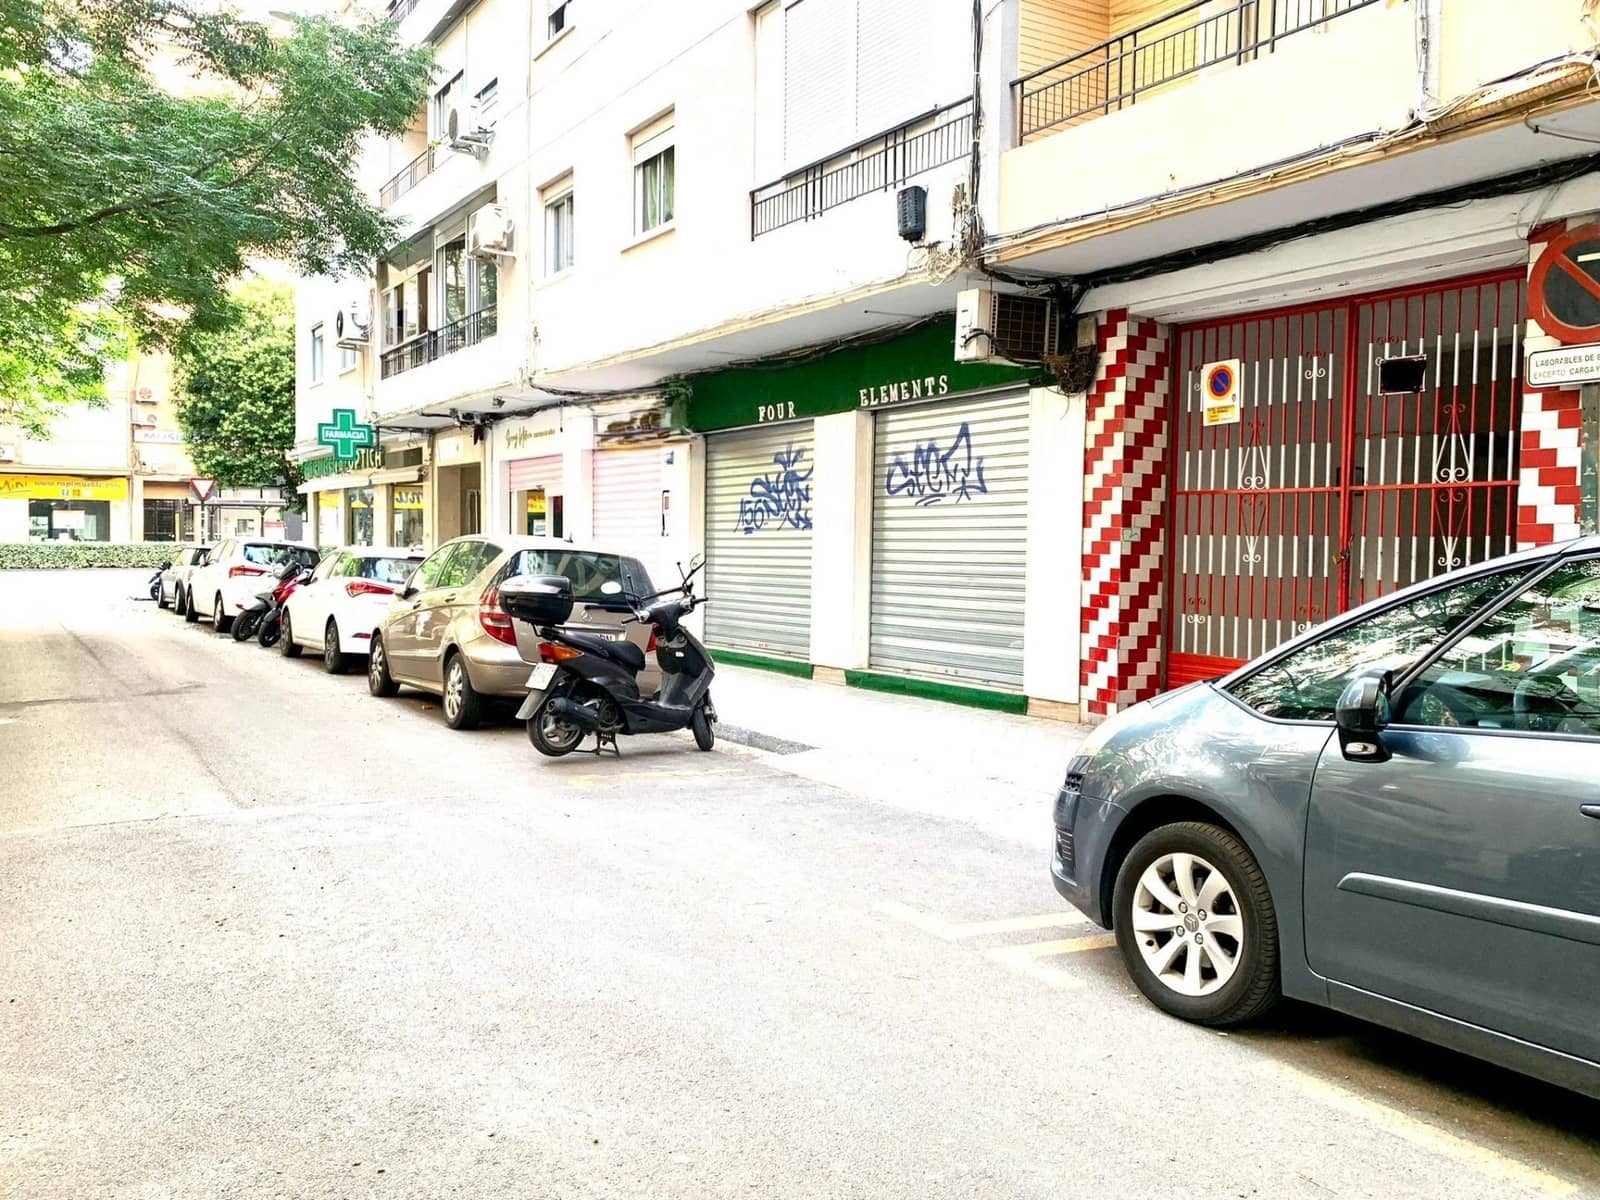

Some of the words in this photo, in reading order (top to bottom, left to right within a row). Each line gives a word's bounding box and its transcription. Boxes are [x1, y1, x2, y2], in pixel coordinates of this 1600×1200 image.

[1535, 355, 1583, 367] LABORABLES
[1584, 353, 1595, 362] DE
[1569, 366, 1594, 375] CARGA
[757, 402, 796, 422] FOUR
[859, 375, 949, 406] ELEMENTS
[325, 430, 365, 439] FARMACIA
